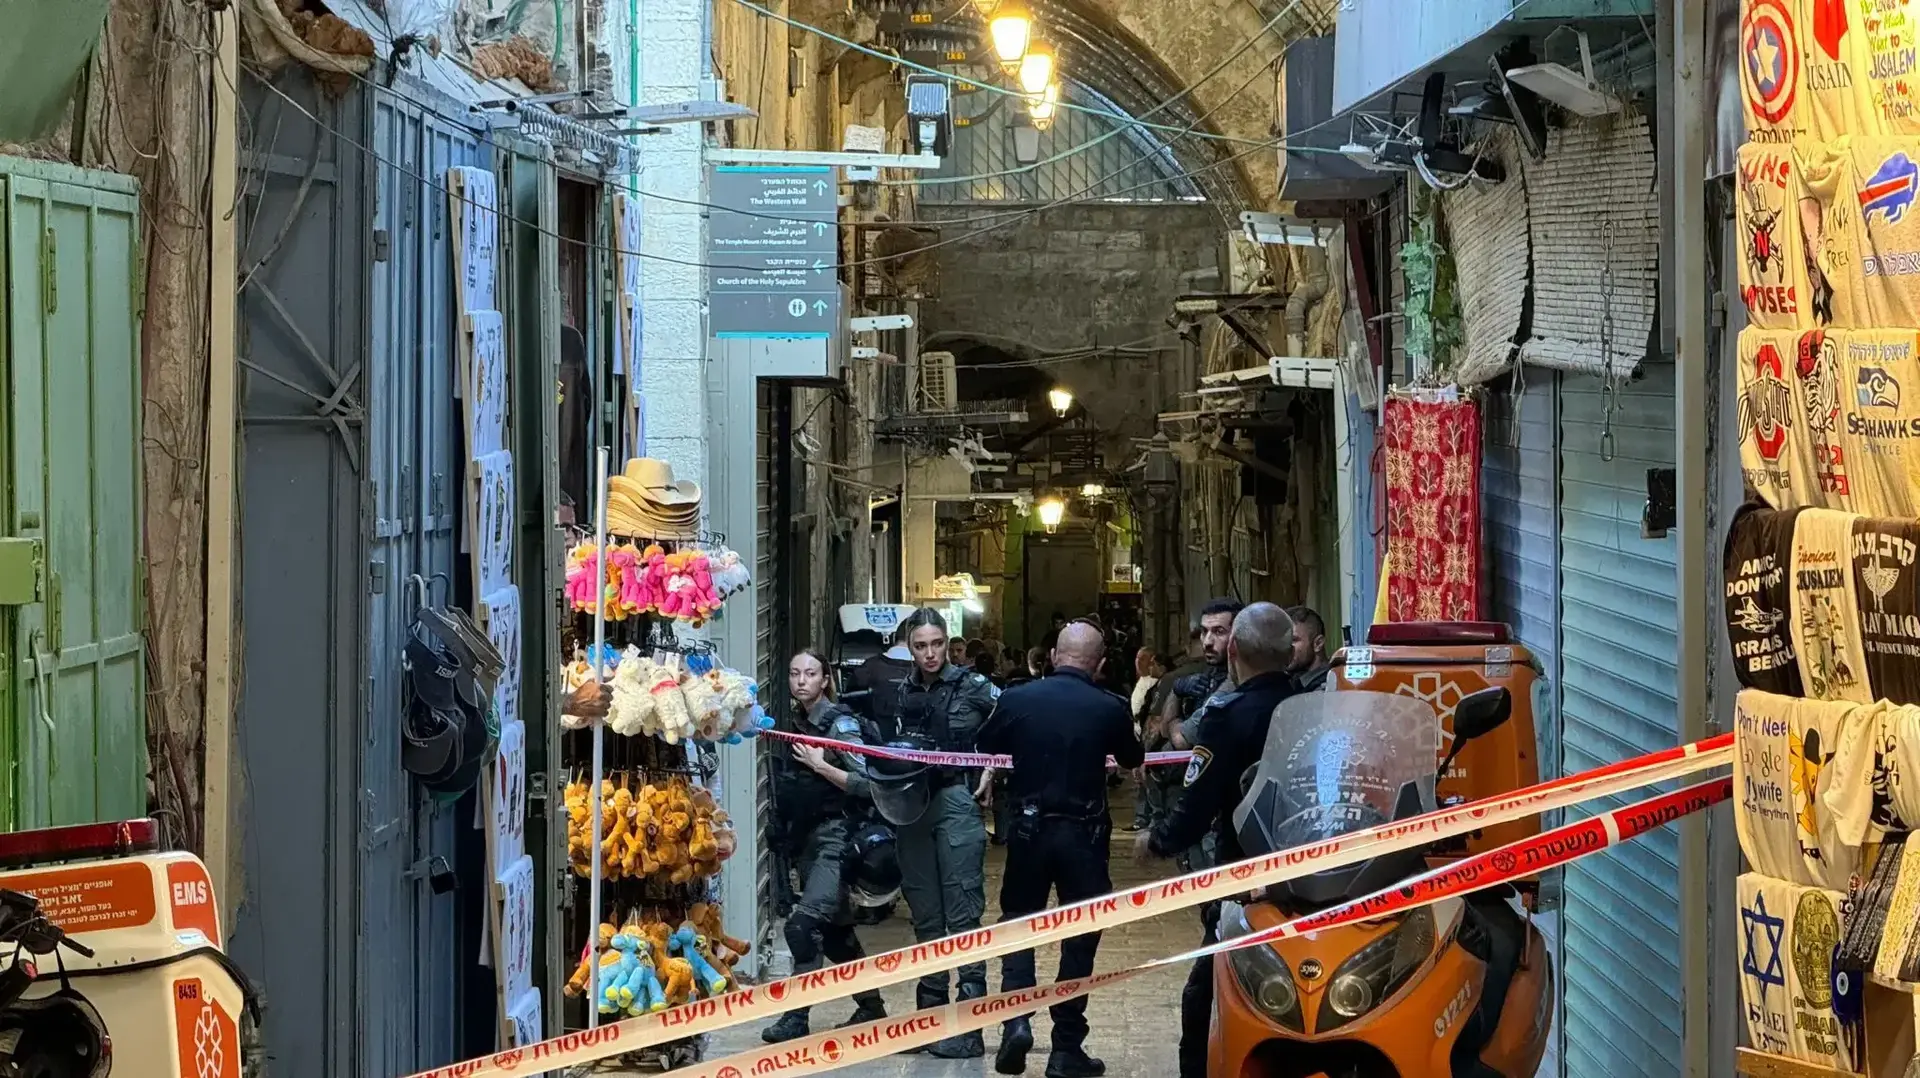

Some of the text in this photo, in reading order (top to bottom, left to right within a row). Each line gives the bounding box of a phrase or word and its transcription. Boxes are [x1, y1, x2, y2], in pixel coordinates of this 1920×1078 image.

[741, 277, 748, 285] of
[760, 278, 774, 287] Holy
[775, 277, 806, 286] Sepulchre
[1880, 533, 1916, 567] קרב
[1759, 781, 1782, 802] wife
[1522, 830, 1599, 865] משטרת
[1422, 863, 1484, 893] ישראל
[62, 894, 82, 905] זאב
[1089, 897, 1117, 921] אין
[1026, 907, 1082, 933] מעבר
[910, 928, 993, 963] משטרת
[798, 961, 865, 992] ישראל
[1299, 963, 1323, 975] SYM
[178, 984, 197, 999] 8435
[725, 989, 755, 1017] אין
[655, 1000, 716, 1028] מעבר
[533, 1022, 621, 1061] משטרת
[851, 1026, 880, 1050] אין
[884, 1015, 941, 1040] מעבר
